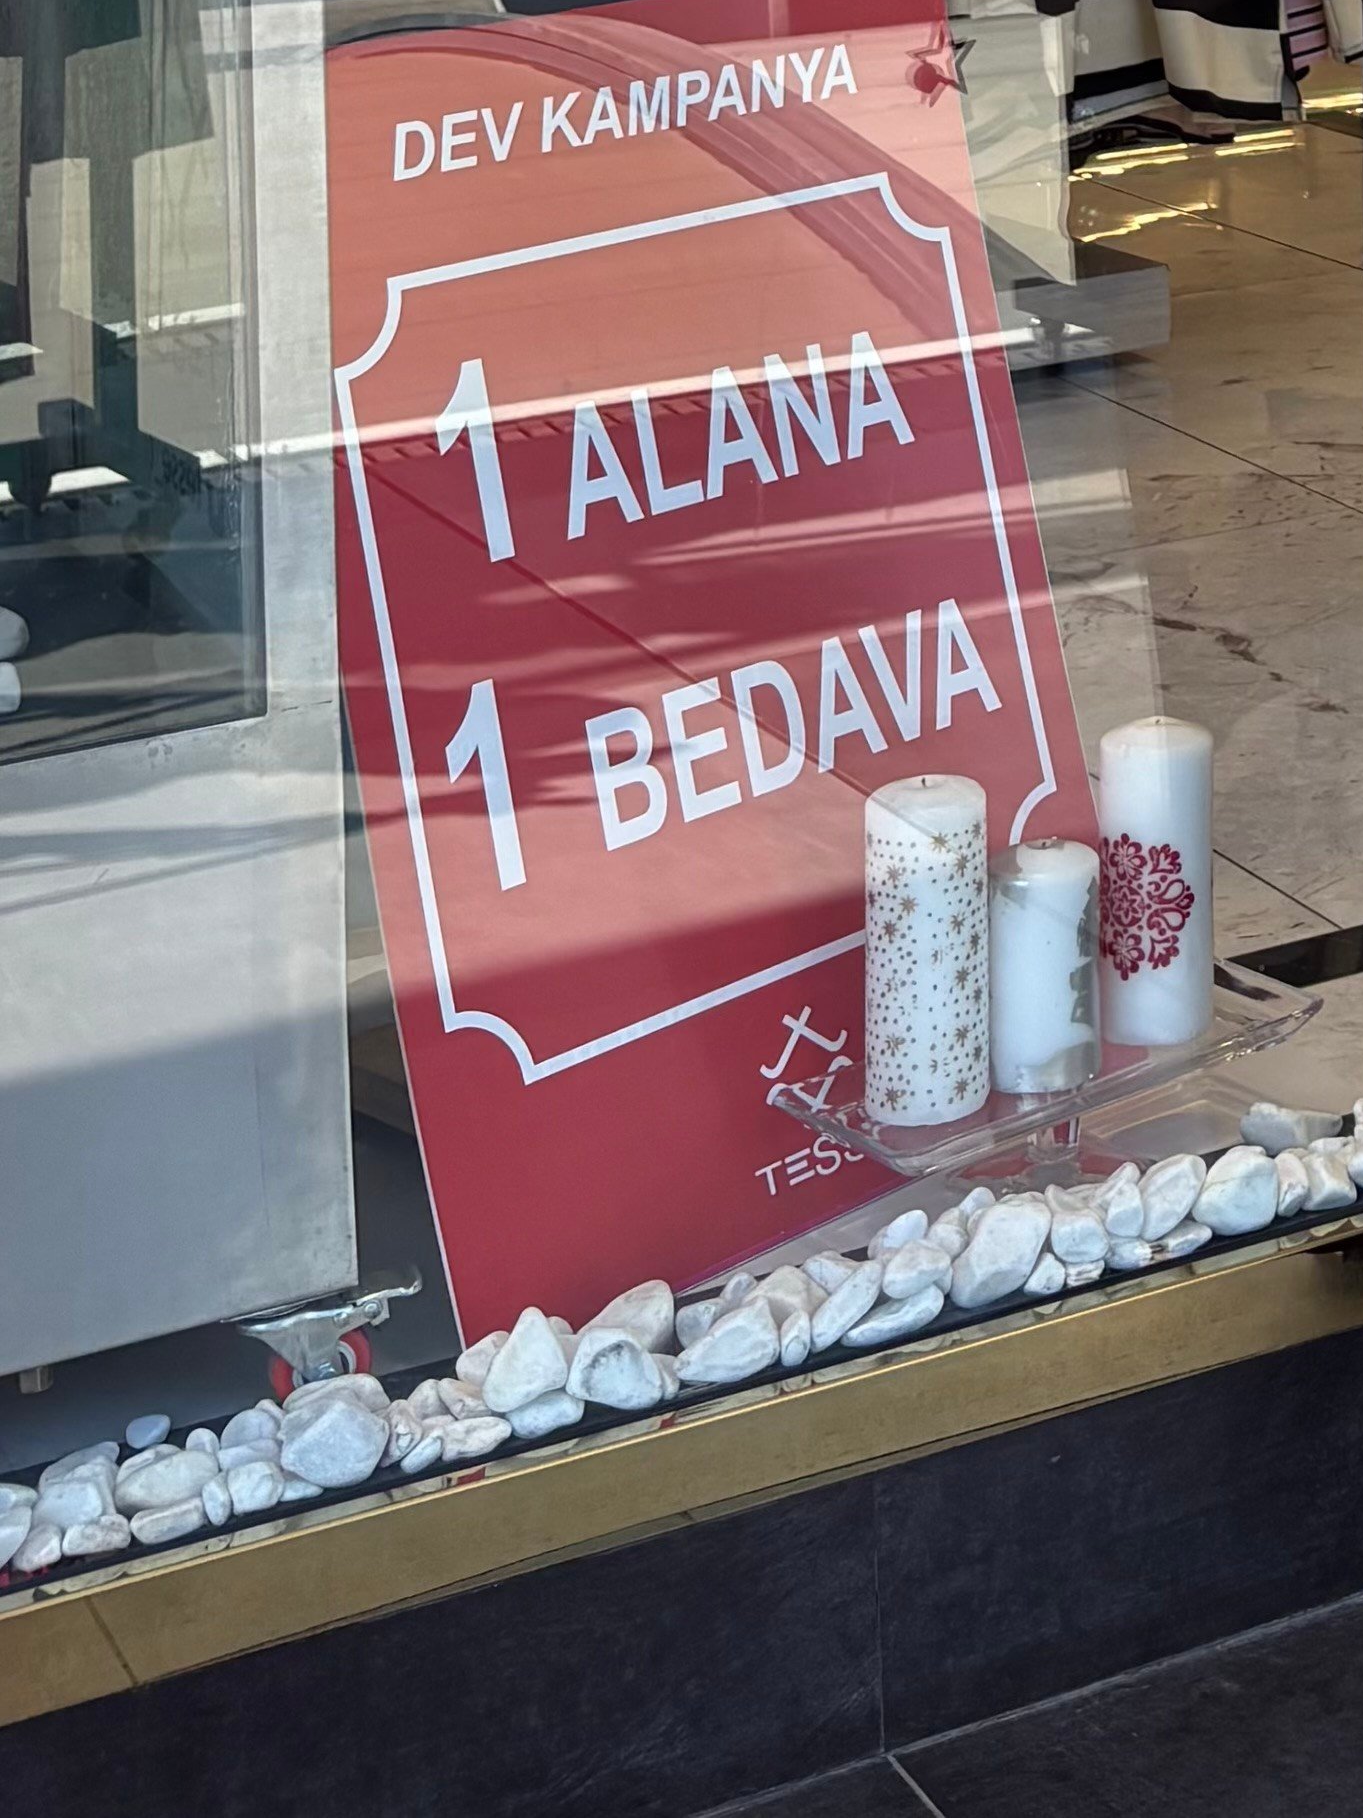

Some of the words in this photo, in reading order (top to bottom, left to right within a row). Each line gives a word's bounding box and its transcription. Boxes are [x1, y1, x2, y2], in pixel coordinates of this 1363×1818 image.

[392, 102, 523, 182] DEV
[539, 43, 860, 155] KAMPANYA
[438, 358, 516, 563] 1
[567, 331, 917, 541] ALANA
[446, 679, 527, 890] 1
[586, 598, 1003, 852] BEDAVA
[755, 1135, 864, 1196] TES
